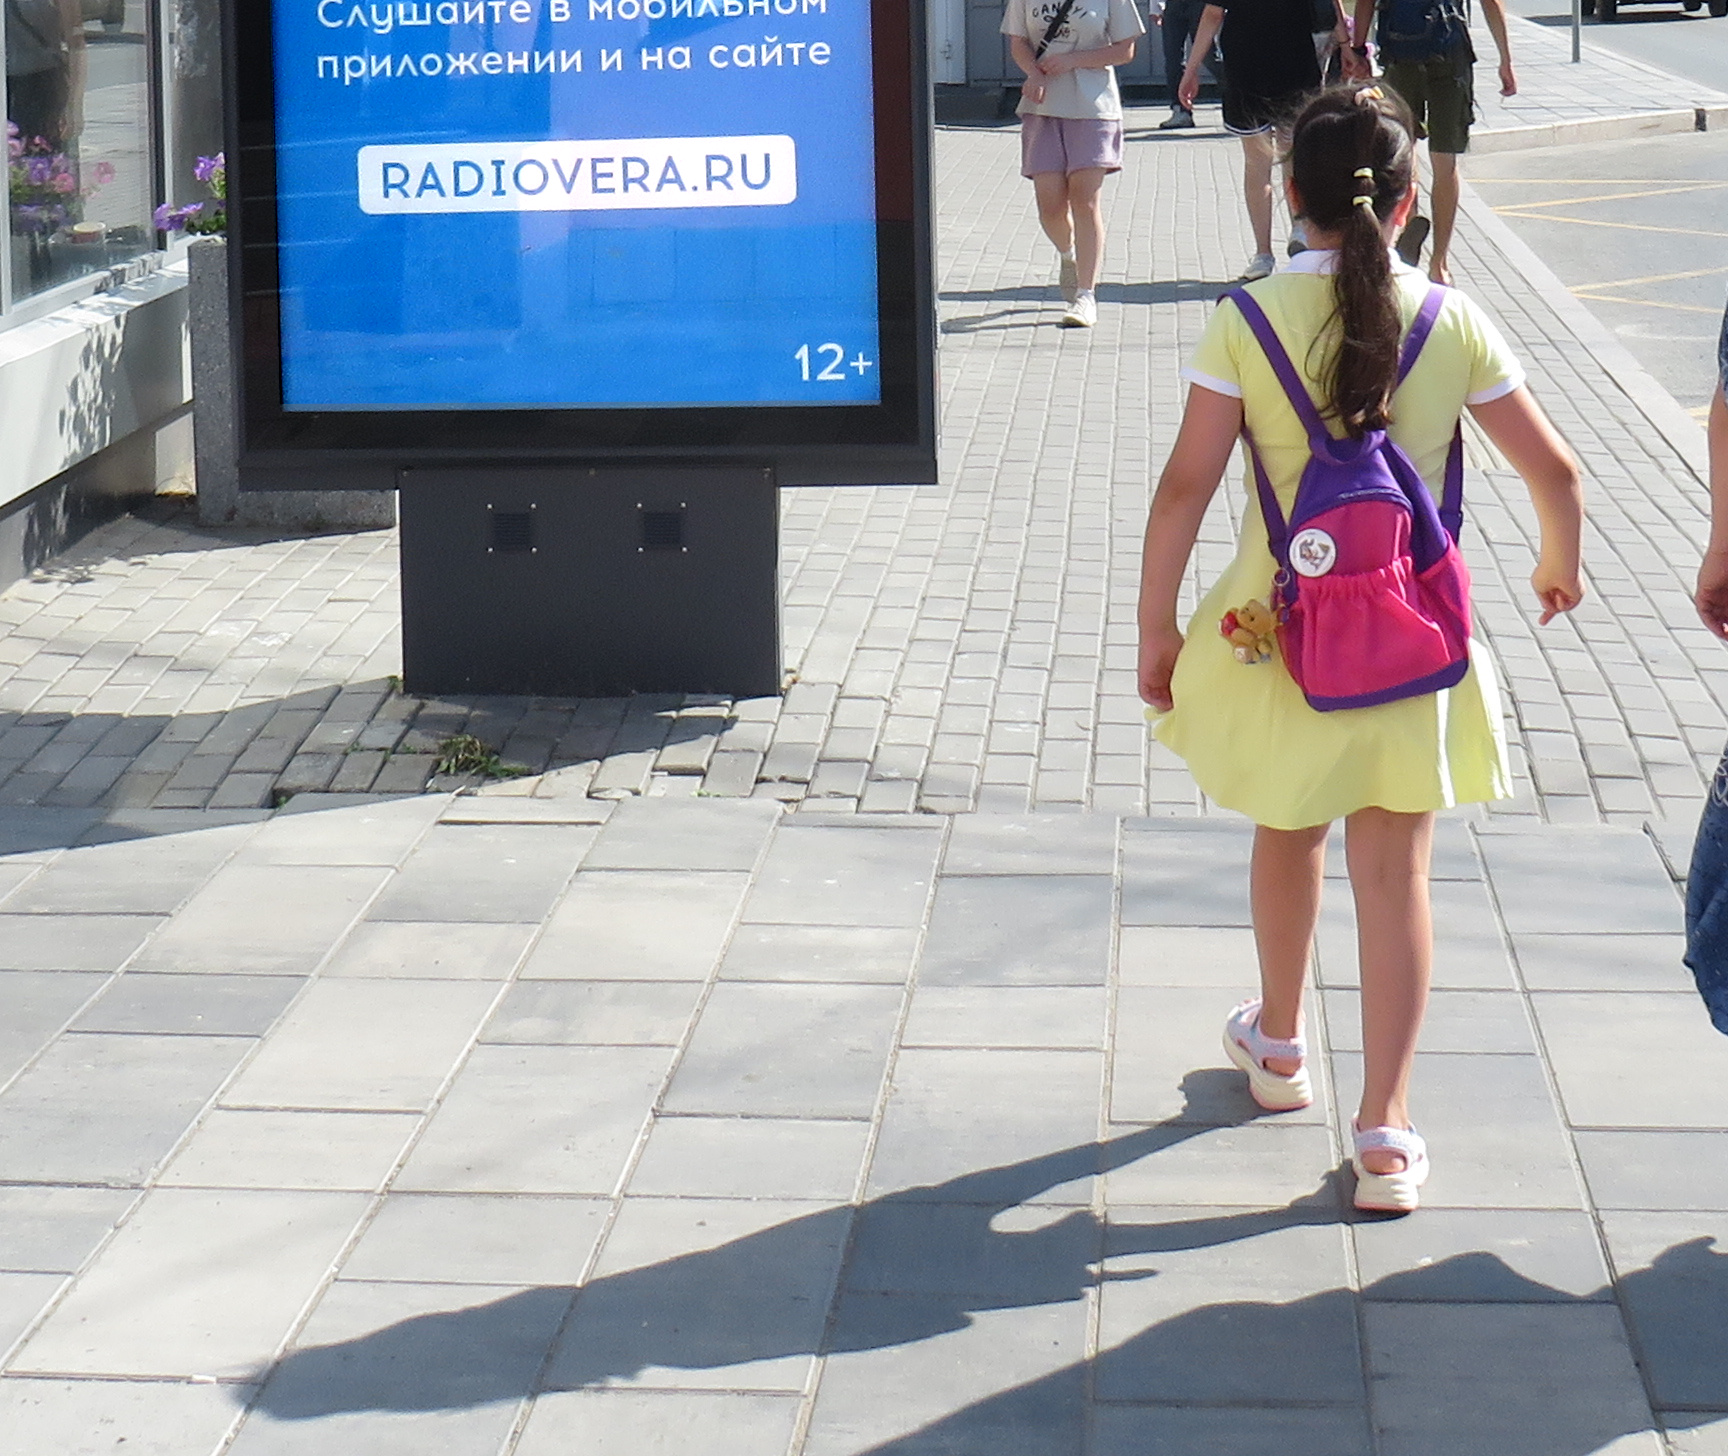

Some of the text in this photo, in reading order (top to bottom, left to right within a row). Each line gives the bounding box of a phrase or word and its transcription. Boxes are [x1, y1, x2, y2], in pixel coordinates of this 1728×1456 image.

[550, 0, 571, 23] в
[316, 35, 833, 87] приложении и на сайте
[381, 153, 773, 200] RADIOVERA.RU
[794, 342, 875, 383] 12+
